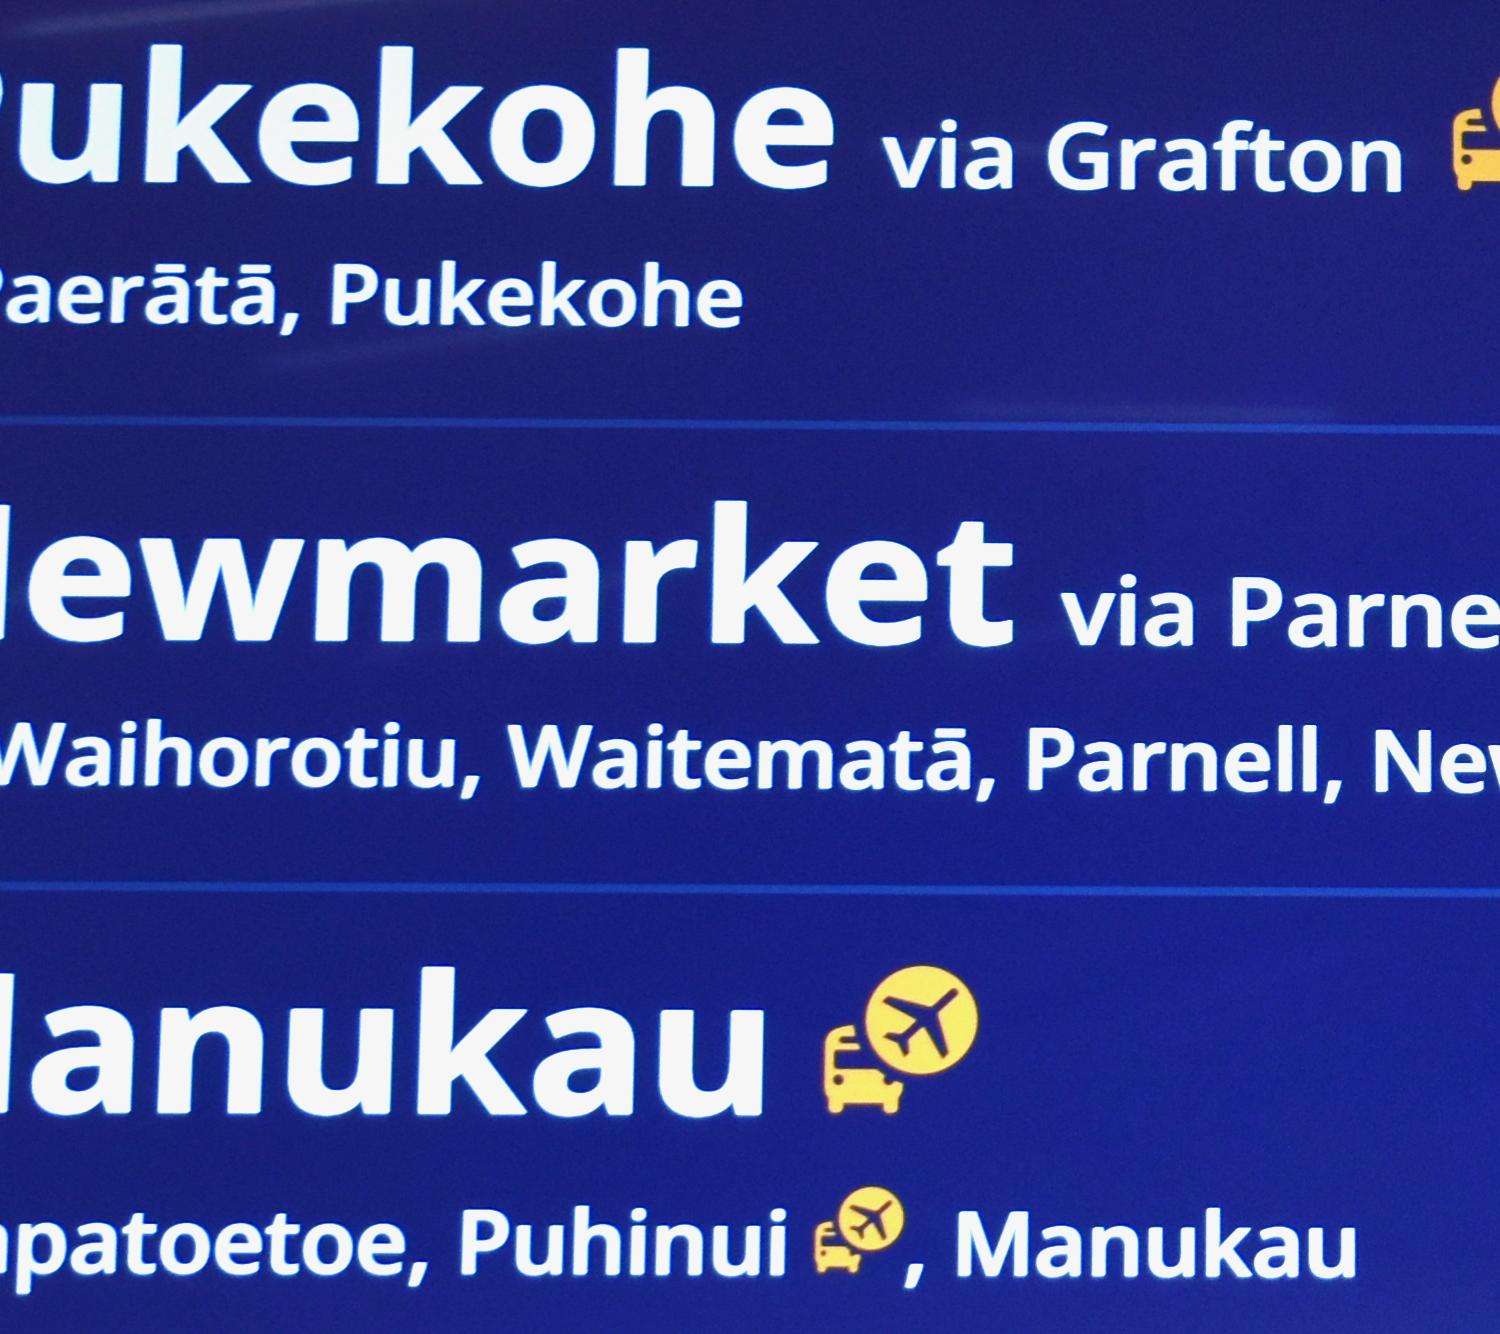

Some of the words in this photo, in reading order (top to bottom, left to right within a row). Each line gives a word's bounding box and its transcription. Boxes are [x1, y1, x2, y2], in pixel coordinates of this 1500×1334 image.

[880, 117, 1014, 191] via
[1046, 118, 1403, 194] Grafton
[330, 258, 744, 330] Pukekohe
[1059, 572, 1195, 649] via
[506, 721, 996, 804] Waitematā,
[1026, 723, 1343, 806] Parnell,
[459, 1203, 788, 1279] Puhinui
[956, 1206, 1357, 1281] Manukau
